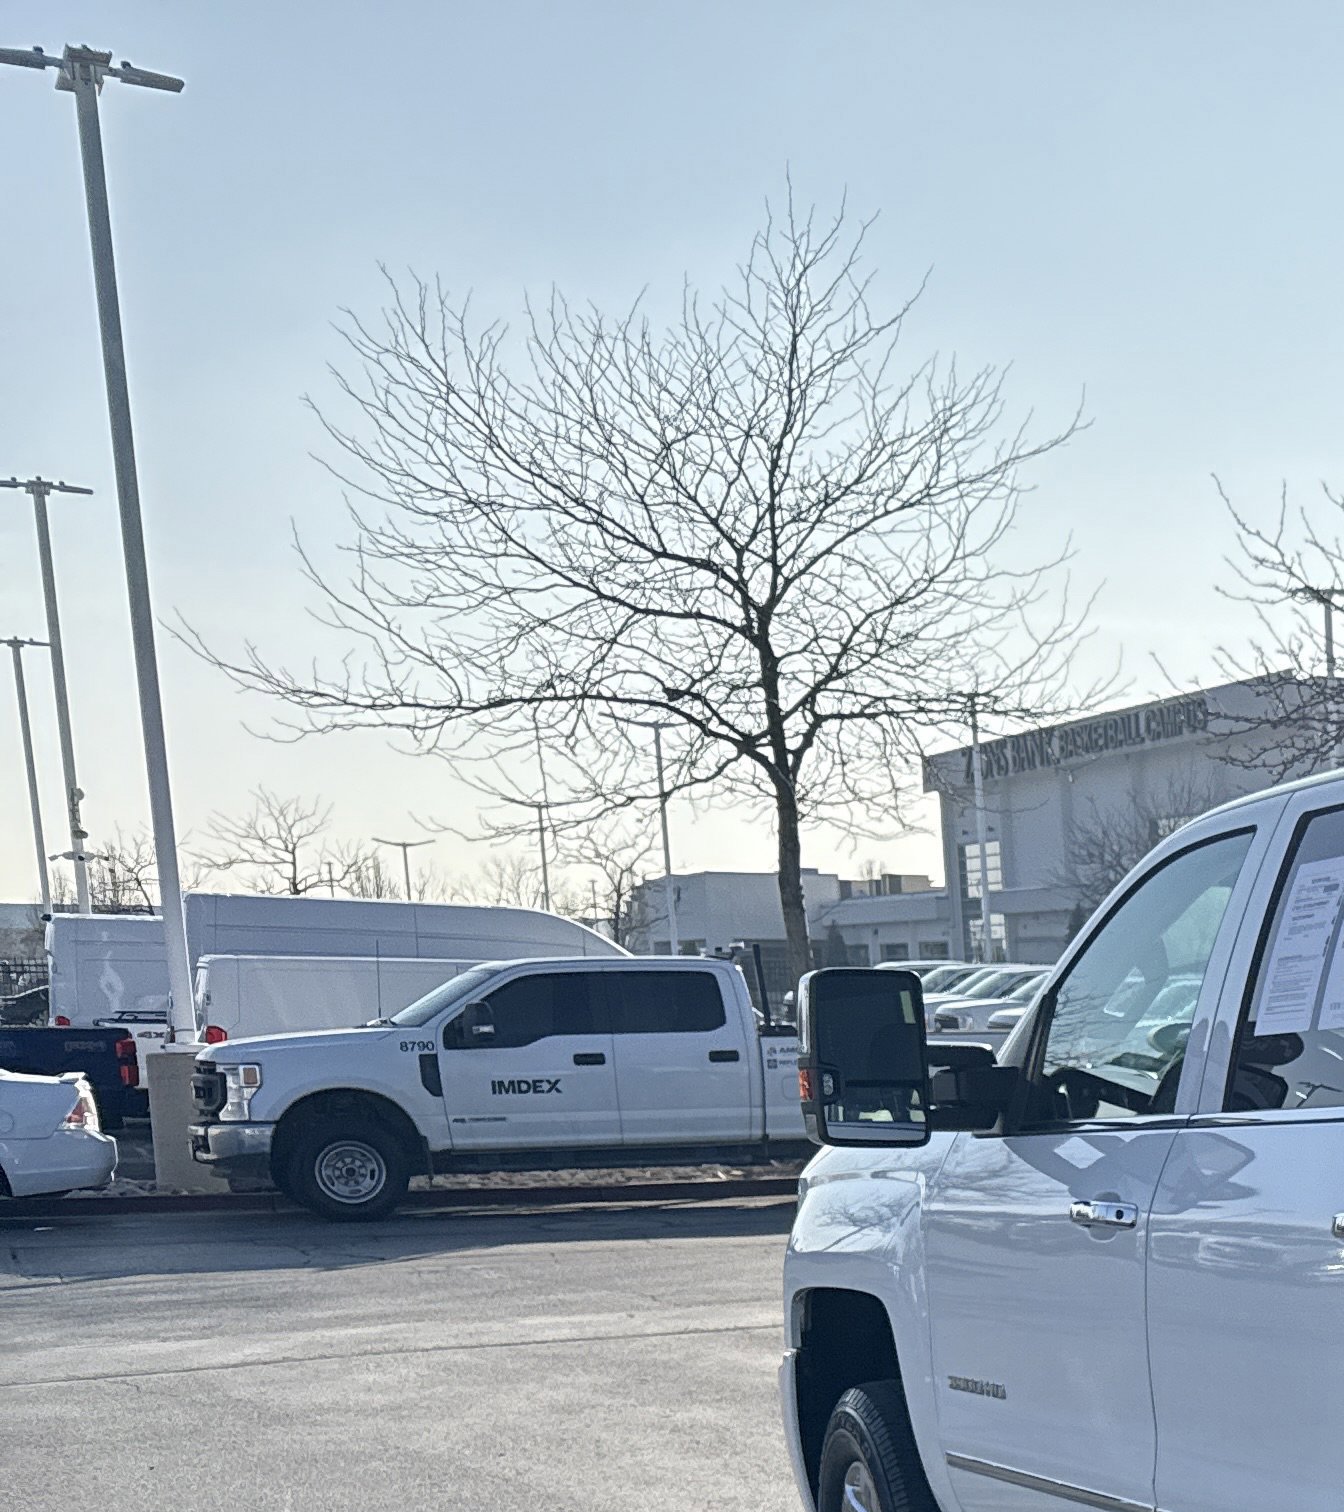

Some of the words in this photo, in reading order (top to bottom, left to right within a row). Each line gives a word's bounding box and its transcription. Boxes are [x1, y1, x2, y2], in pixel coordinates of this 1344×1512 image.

[961, 744, 1009, 783] ZONS
[1059, 711, 1145, 758] BASKETBALL
[1145, 700, 1208, 741] CAMPUS
[400, 1041, 435, 1052] 8790
[491, 1079, 563, 1095] IMDEX
